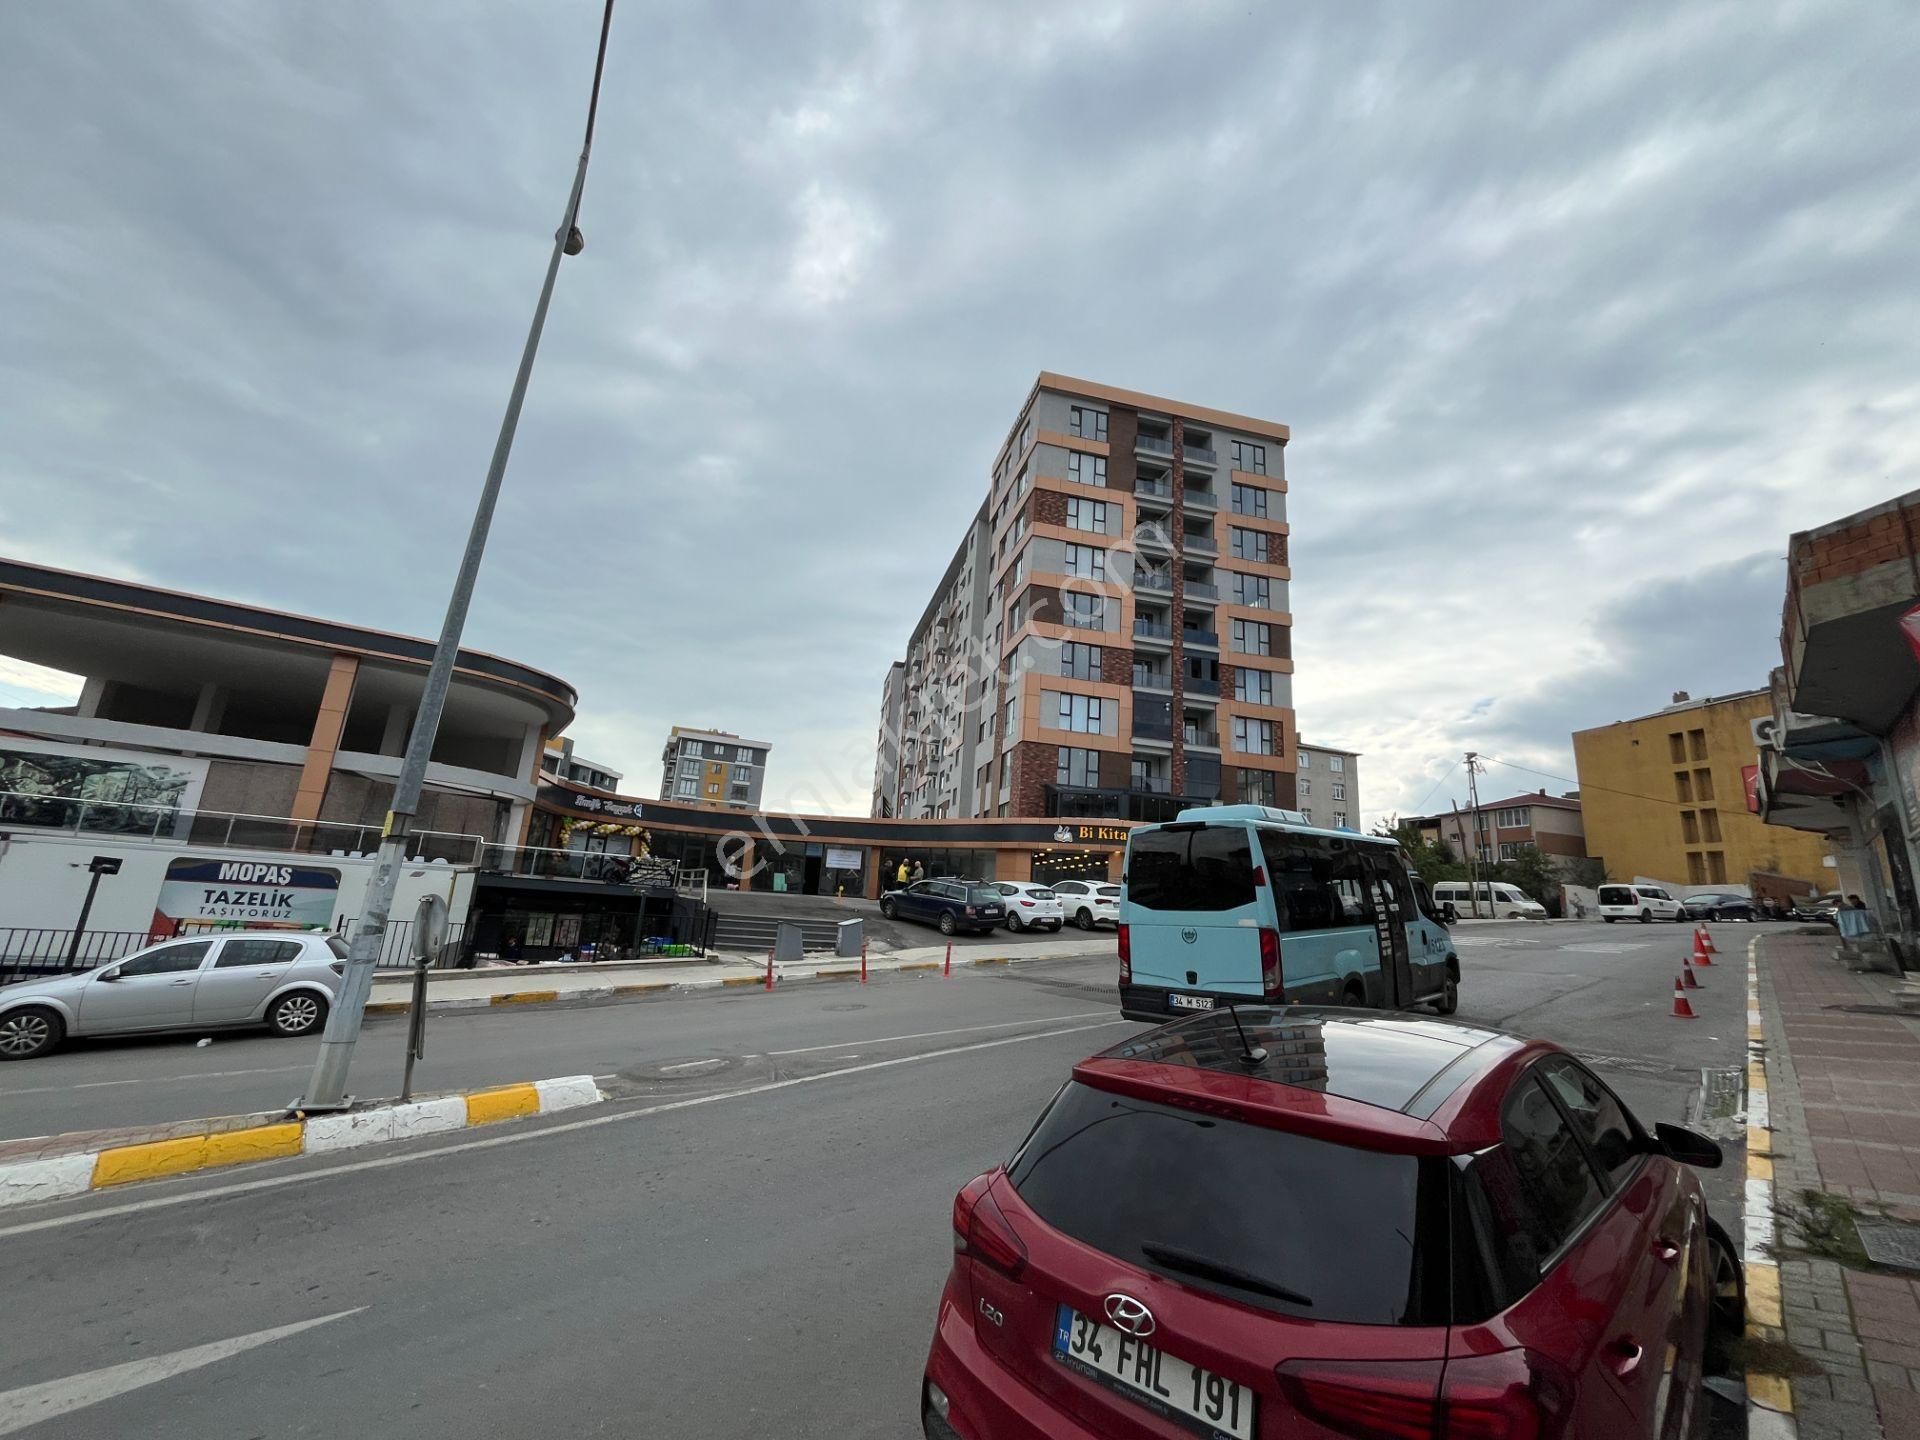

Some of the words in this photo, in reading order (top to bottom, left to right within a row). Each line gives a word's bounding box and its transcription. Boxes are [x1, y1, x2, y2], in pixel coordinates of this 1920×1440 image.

[1079, 826, 1093, 839] Bi
[1098, 827, 1127, 840] Kita
[218, 863, 292, 886] MOPAŞ
[204, 889, 294, 908] TAZELİK
[199, 906, 291, 918] TAŞIYORUZ
[1174, 996, 1183, 1006] 34
[1186, 998, 1193, 1007] M
[1196, 999, 1213, 1009] 5123
[1059, 1328, 1069, 1343] TR
[1071, 1312, 1102, 1363] 34
[1117, 1333, 1170, 1398] FHL
[1191, 1367, 1240, 1430] 191
